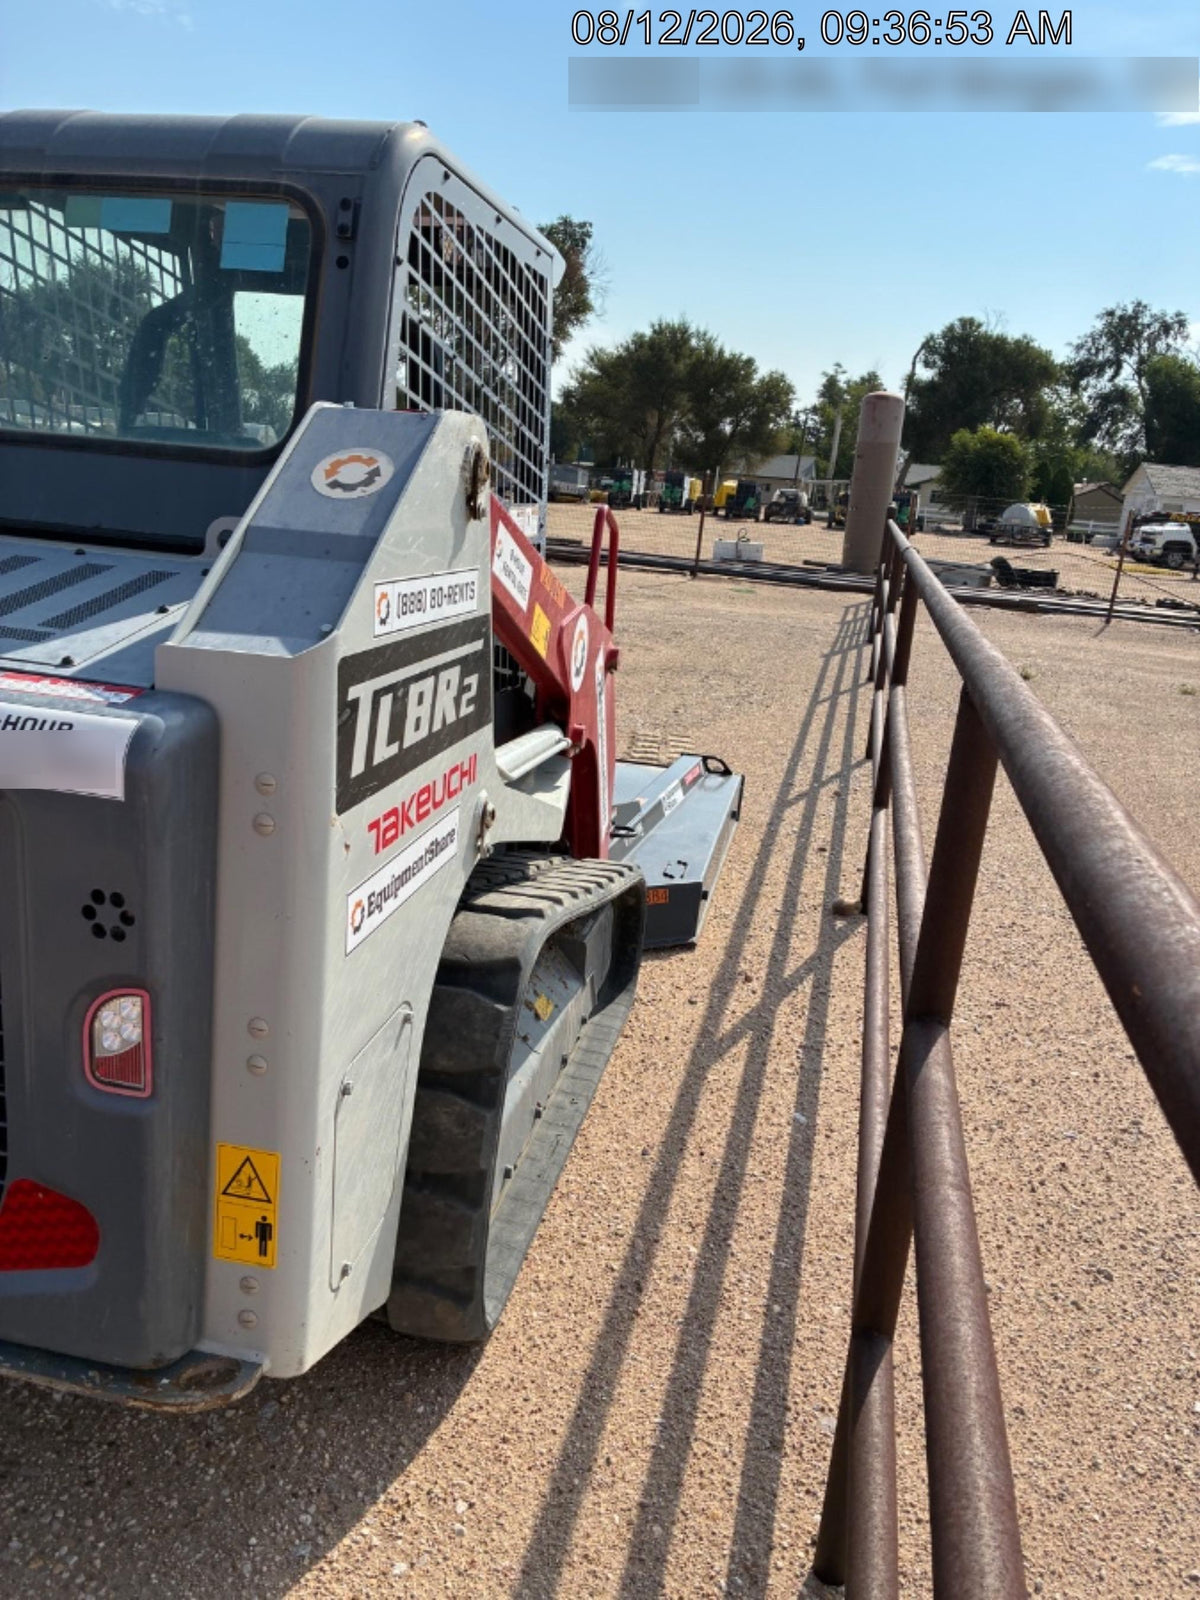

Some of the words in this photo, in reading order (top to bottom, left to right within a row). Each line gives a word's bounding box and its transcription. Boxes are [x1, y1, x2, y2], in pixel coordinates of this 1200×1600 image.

[397, 588, 427, 619] (888)
[430, 580, 476, 610] 80-RENTS
[367, 753, 477, 855] TAKEUCHI
[366, 827, 456, 919] EquipmentShare
